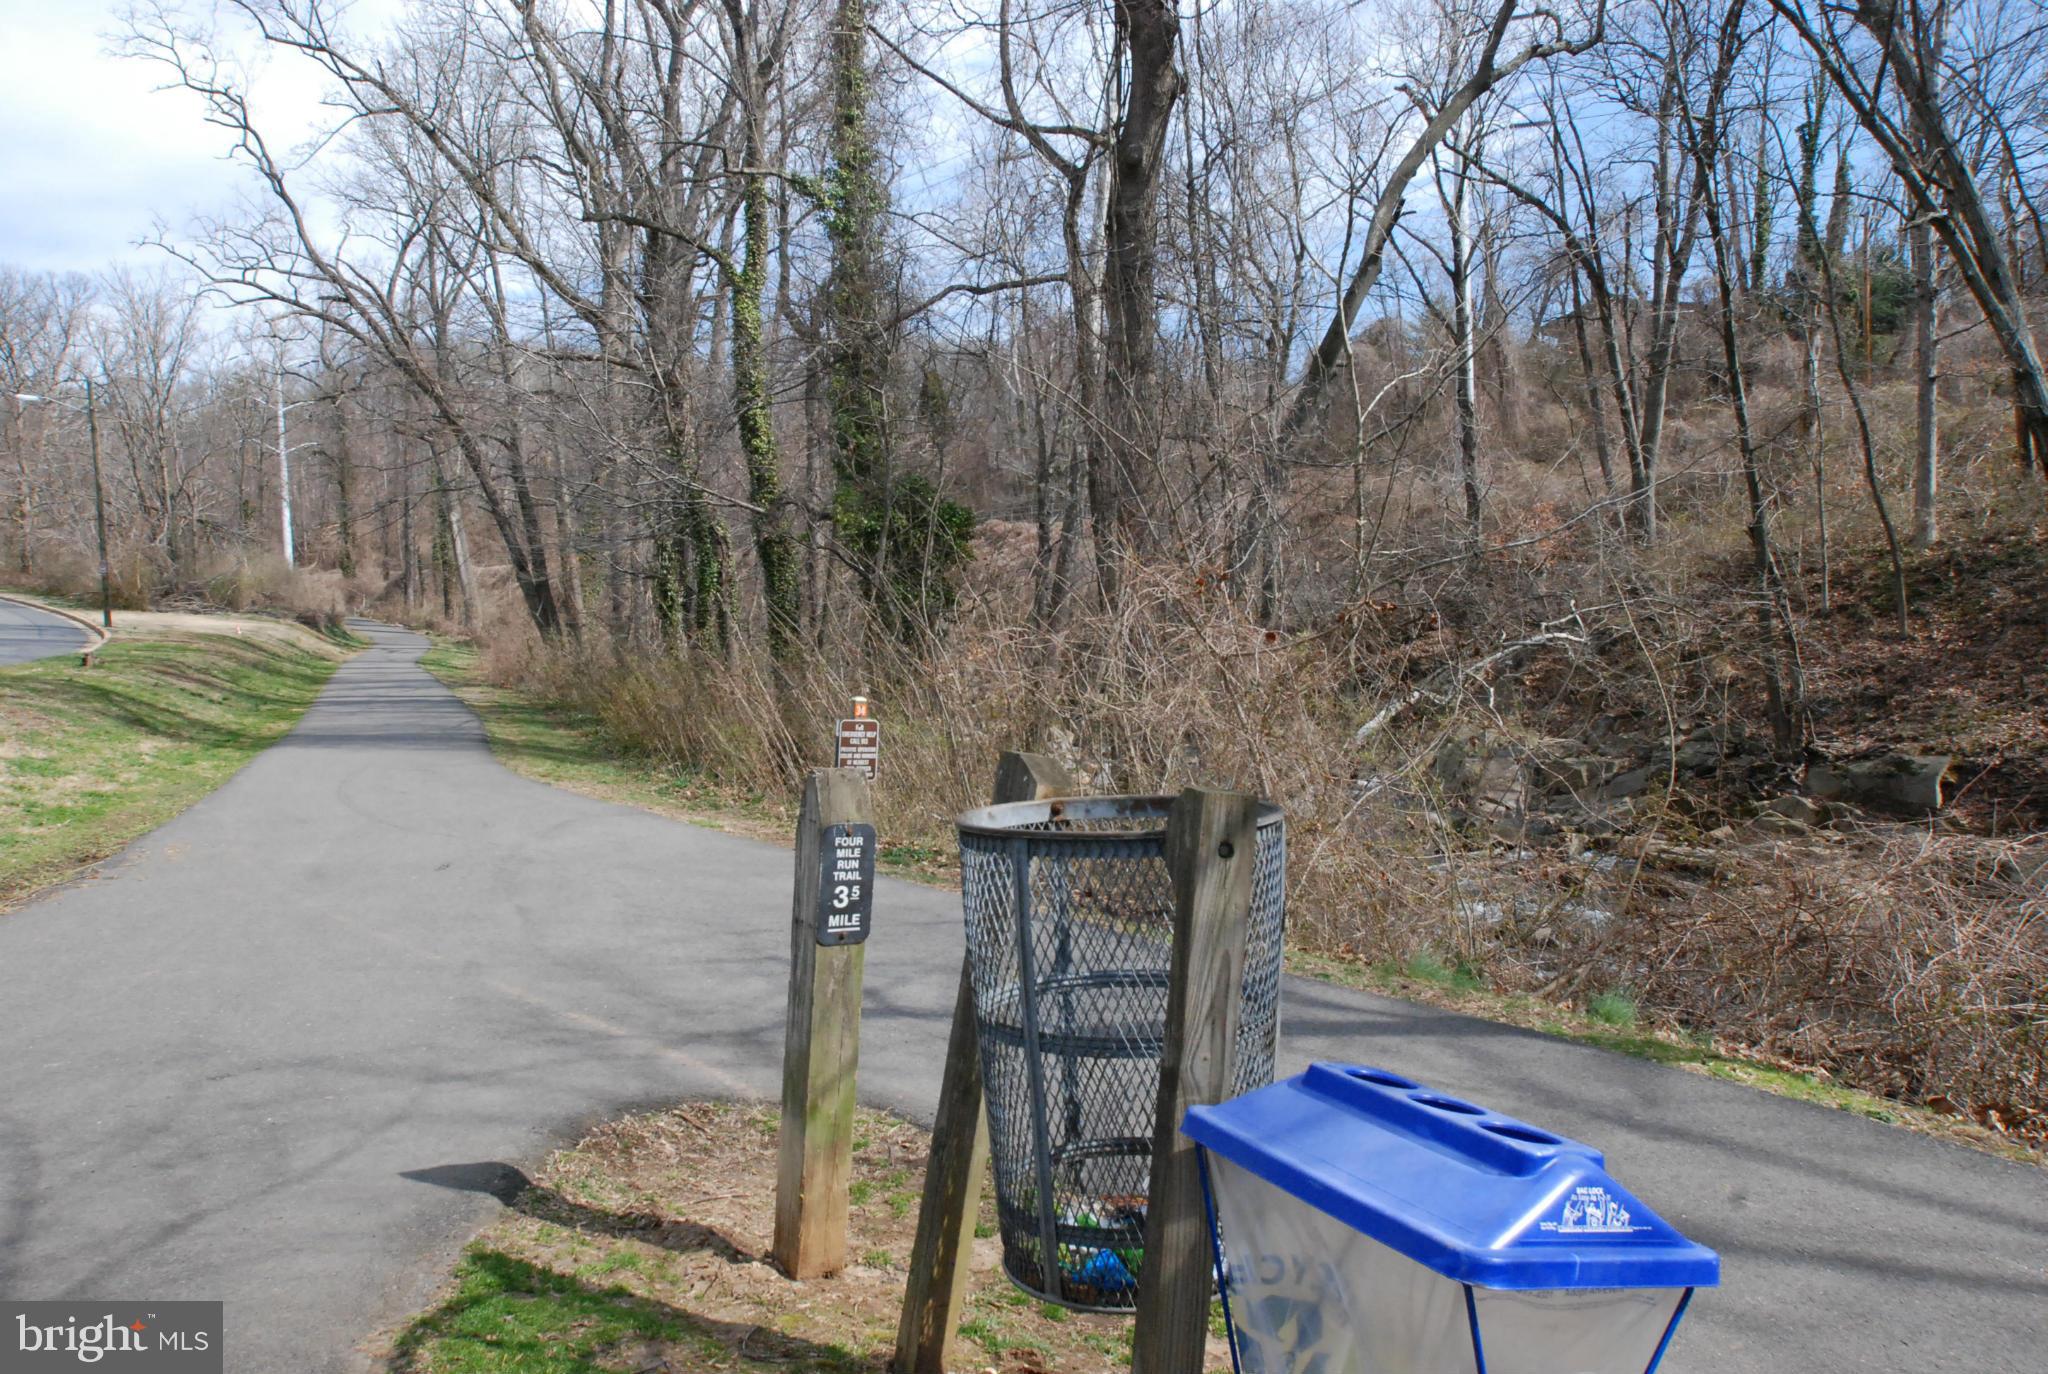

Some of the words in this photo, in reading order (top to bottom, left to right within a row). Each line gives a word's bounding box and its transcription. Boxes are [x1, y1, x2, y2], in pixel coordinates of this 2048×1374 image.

[835, 837, 863, 847] FOUR
[836, 848, 861, 858] MILE
[837, 859, 859, 869] RUN
[833, 871, 862, 881] TRAIL
[828, 914, 861, 927] MILE
